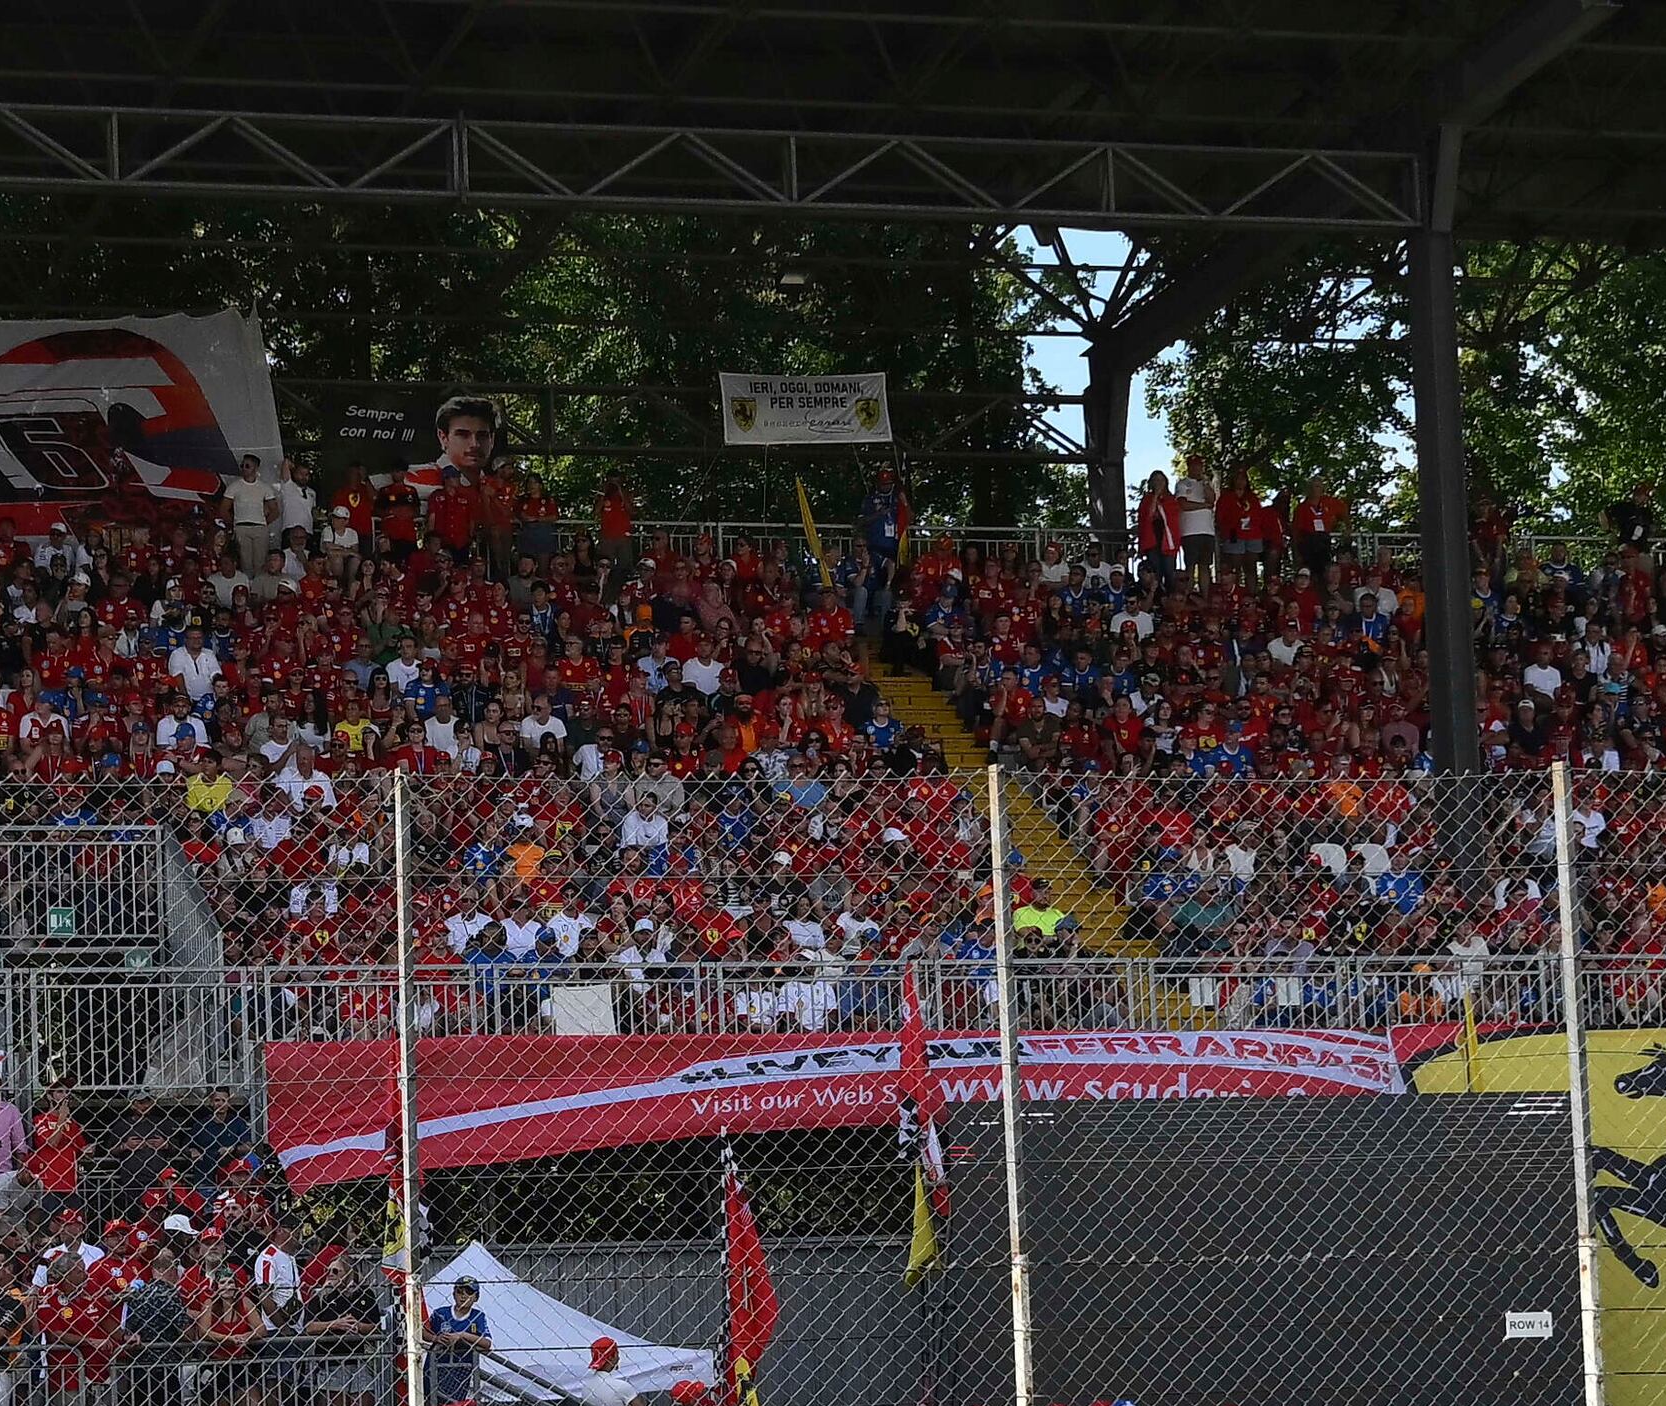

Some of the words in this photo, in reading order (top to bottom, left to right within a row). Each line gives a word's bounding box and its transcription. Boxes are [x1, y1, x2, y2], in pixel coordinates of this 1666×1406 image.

[770, 397, 794, 409] PER
[798, 397, 847, 409] SEMPRE
[345, 405, 405, 422] Sempre
[339, 427, 367, 438] con
[372, 428, 396, 440] noi
[691, 1094, 753, 1116] Visit
[760, 1091, 805, 1111] our
[812, 1085, 874, 1108] Web
[1508, 1319, 1534, 1331] ROW
[1537, 1319, 1550, 1331] 14
